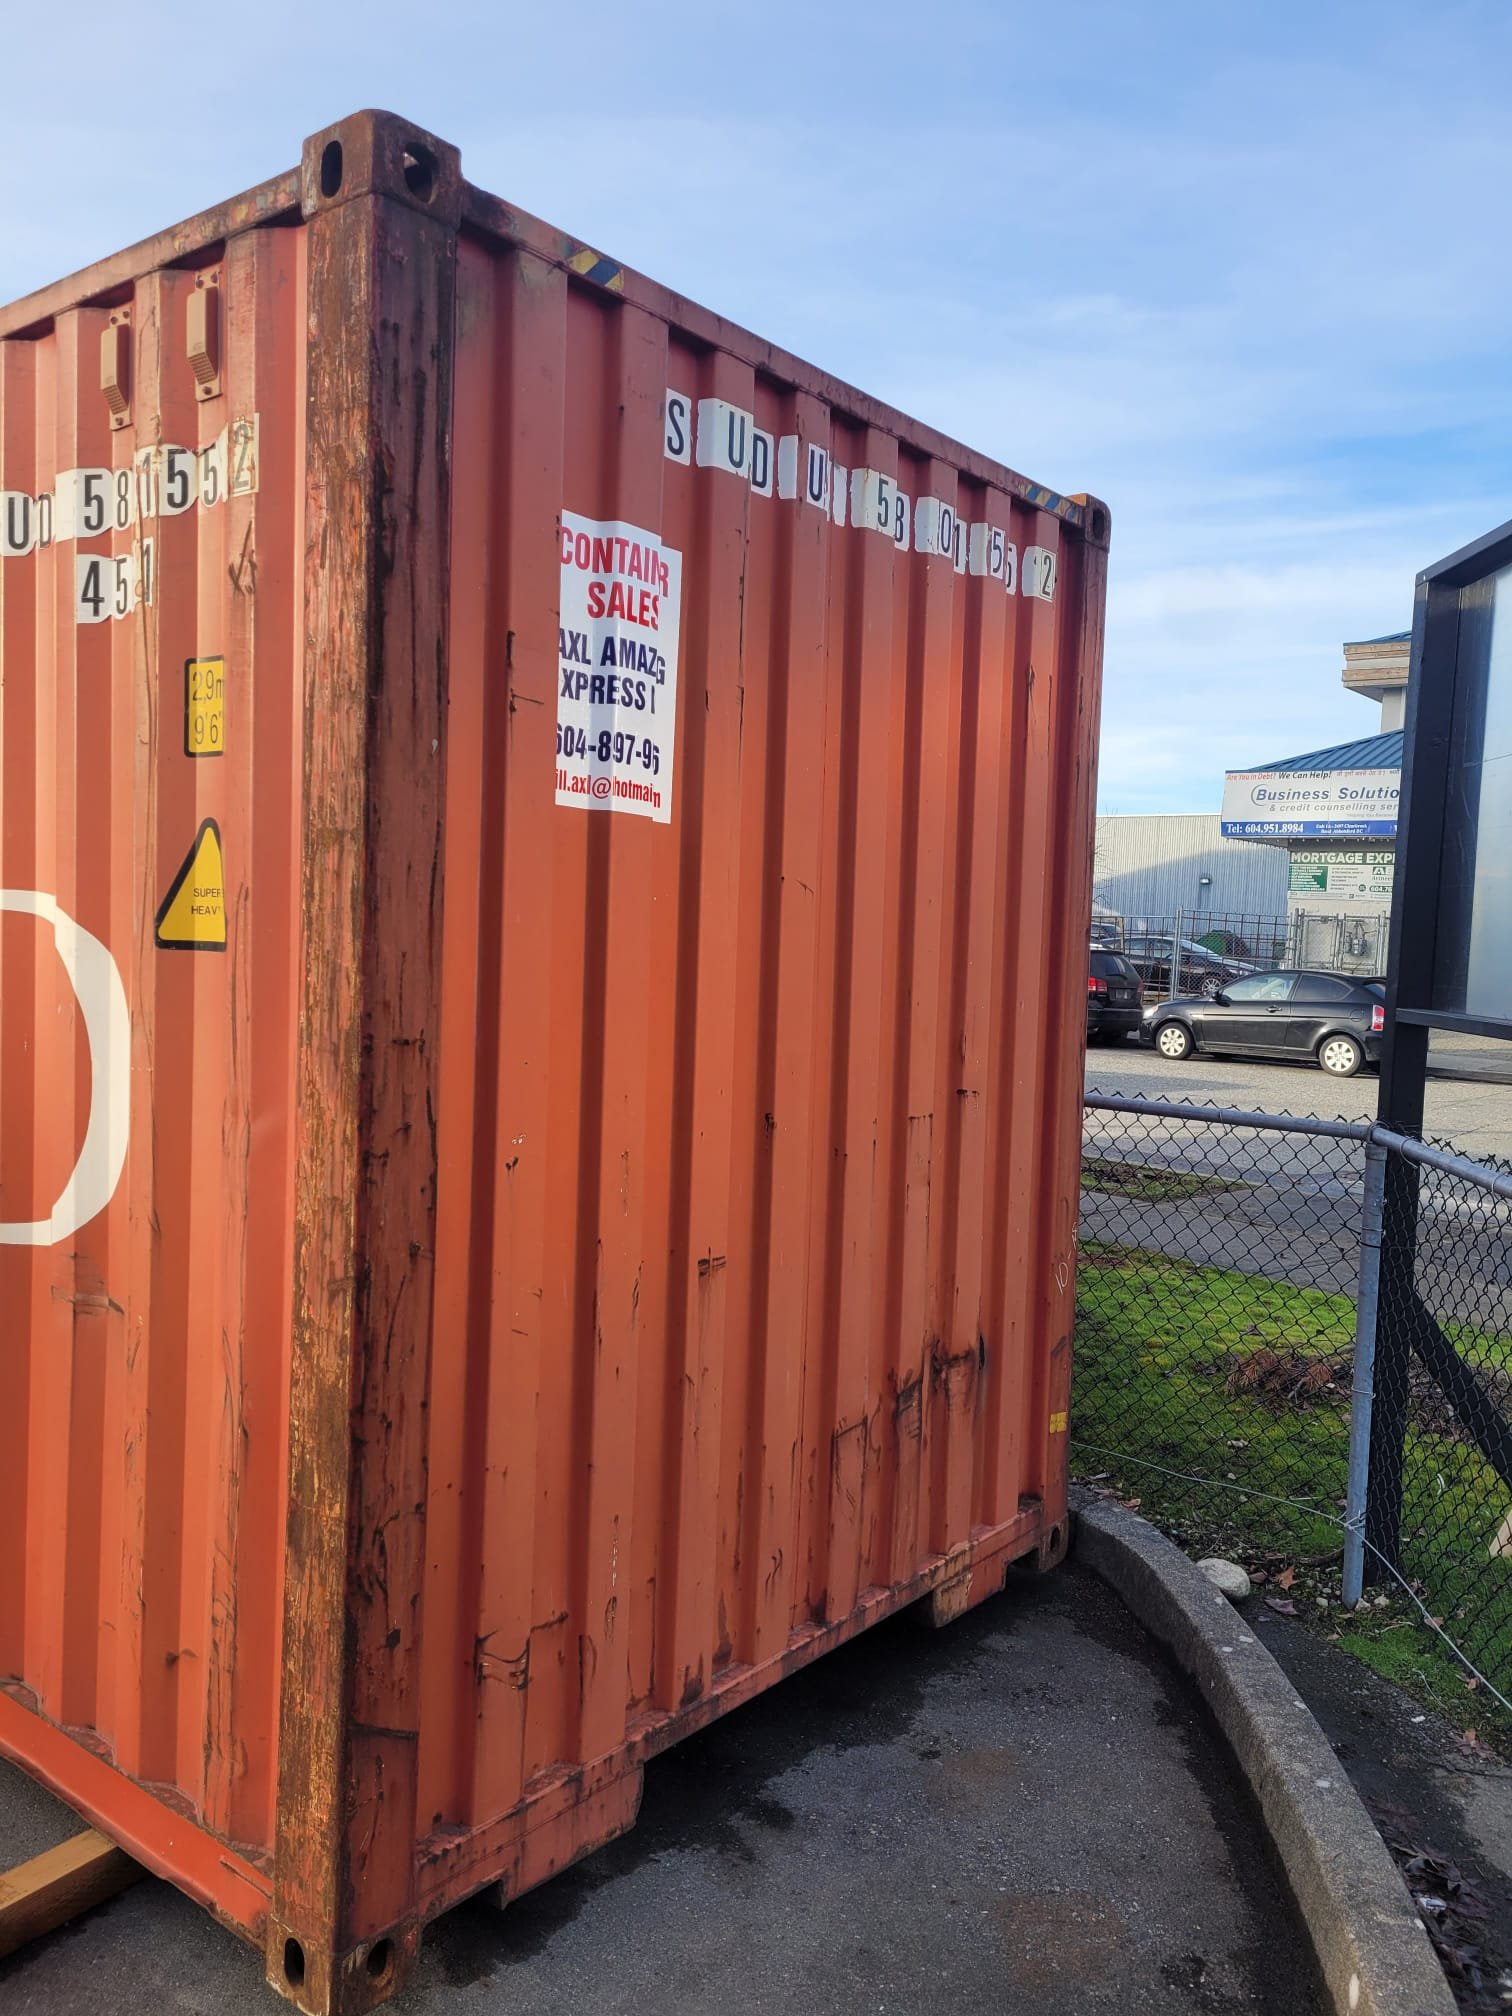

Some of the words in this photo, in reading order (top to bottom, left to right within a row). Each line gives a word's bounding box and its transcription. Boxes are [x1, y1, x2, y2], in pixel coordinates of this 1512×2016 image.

[587, 581, 660, 631] SALES
[1279, 771, 1290, 779] We
[1293, 771, 1308, 779] Can
[1310, 770, 1331, 780] Help!
[1256, 788, 1330, 801] Business
[1280, 804, 1310, 812] credit
[1314, 803, 1377, 812] counselling
[1226, 823, 1242, 833] Tel:
[1245, 823, 1304, 833] 604.951.8984
[1291, 852, 1363, 864] MORTGAGE
